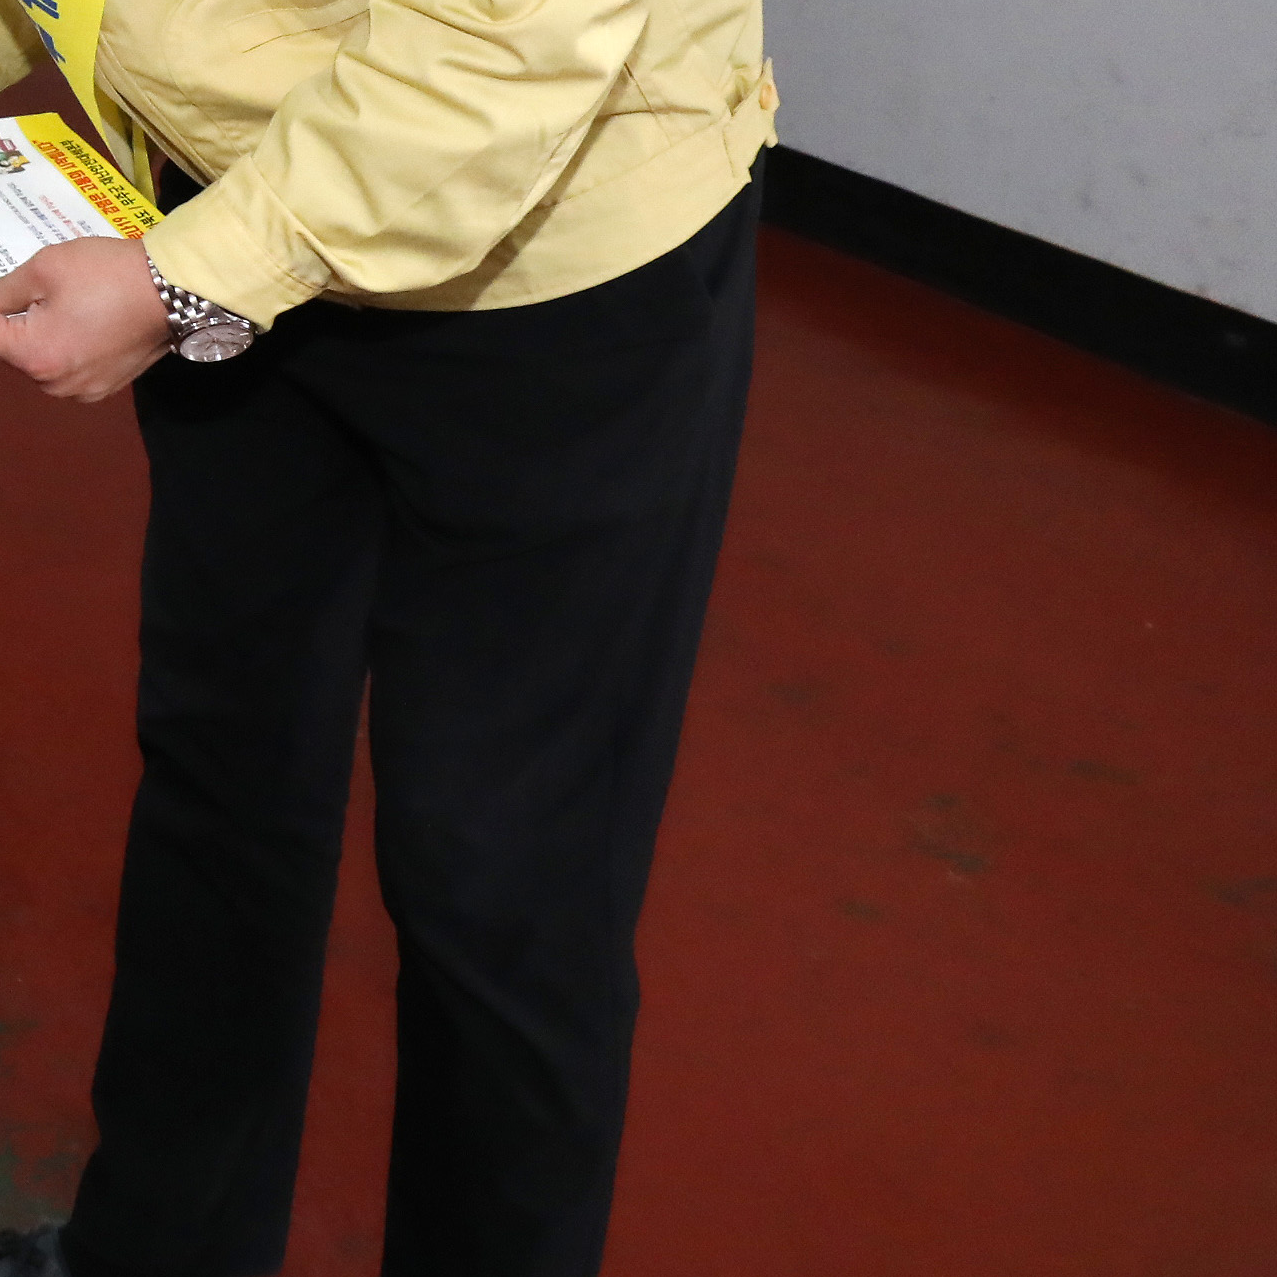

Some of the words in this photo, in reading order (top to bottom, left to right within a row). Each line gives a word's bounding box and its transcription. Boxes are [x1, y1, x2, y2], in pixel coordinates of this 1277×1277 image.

[59, 140, 113, 186] 재난안전대책본부
[67, 170, 98, 193] 고통의
[88, 192, 120, 215] 감염은
[108, 185, 136, 206] 무주군
